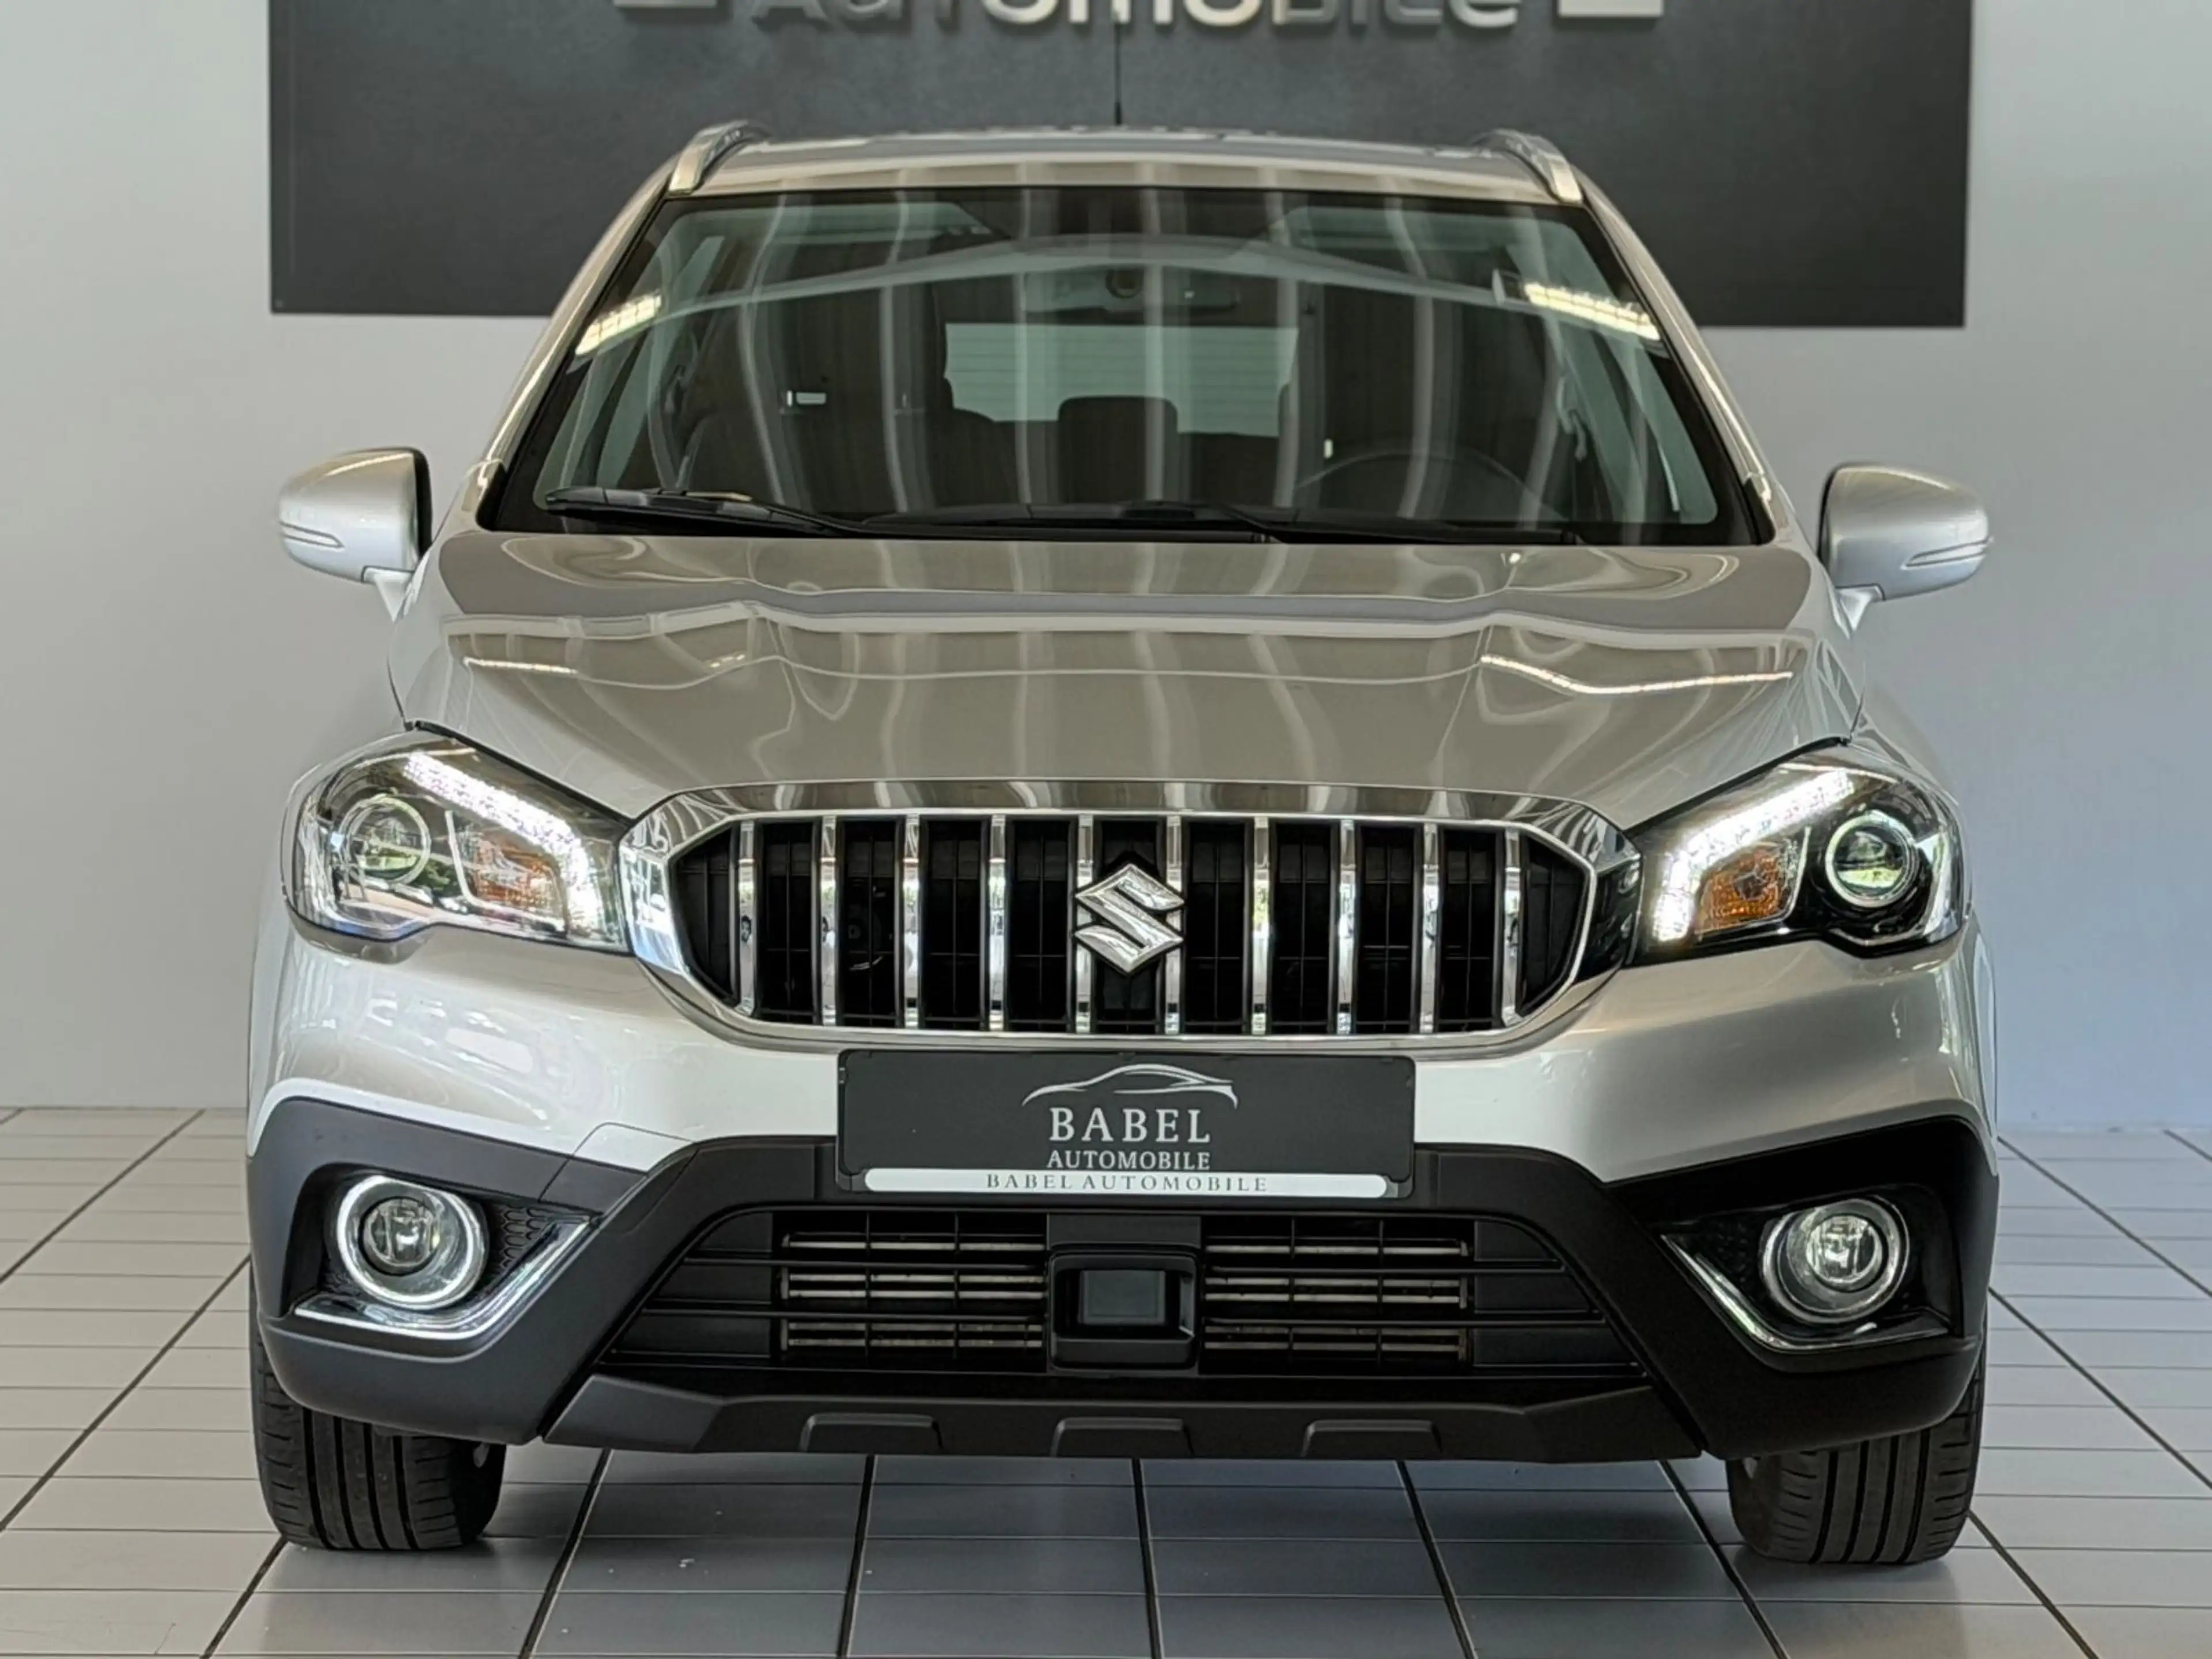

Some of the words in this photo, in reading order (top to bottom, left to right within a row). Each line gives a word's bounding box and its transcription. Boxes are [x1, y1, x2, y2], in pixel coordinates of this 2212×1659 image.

[1049, 1107, 1210, 1143] BABEL
[1046, 1150, 1210, 1171] AUTOMOBILE
[987, 1173, 1073, 1190] BABEL
[1082, 1175, 1268, 1192] AUTOMOBILE
